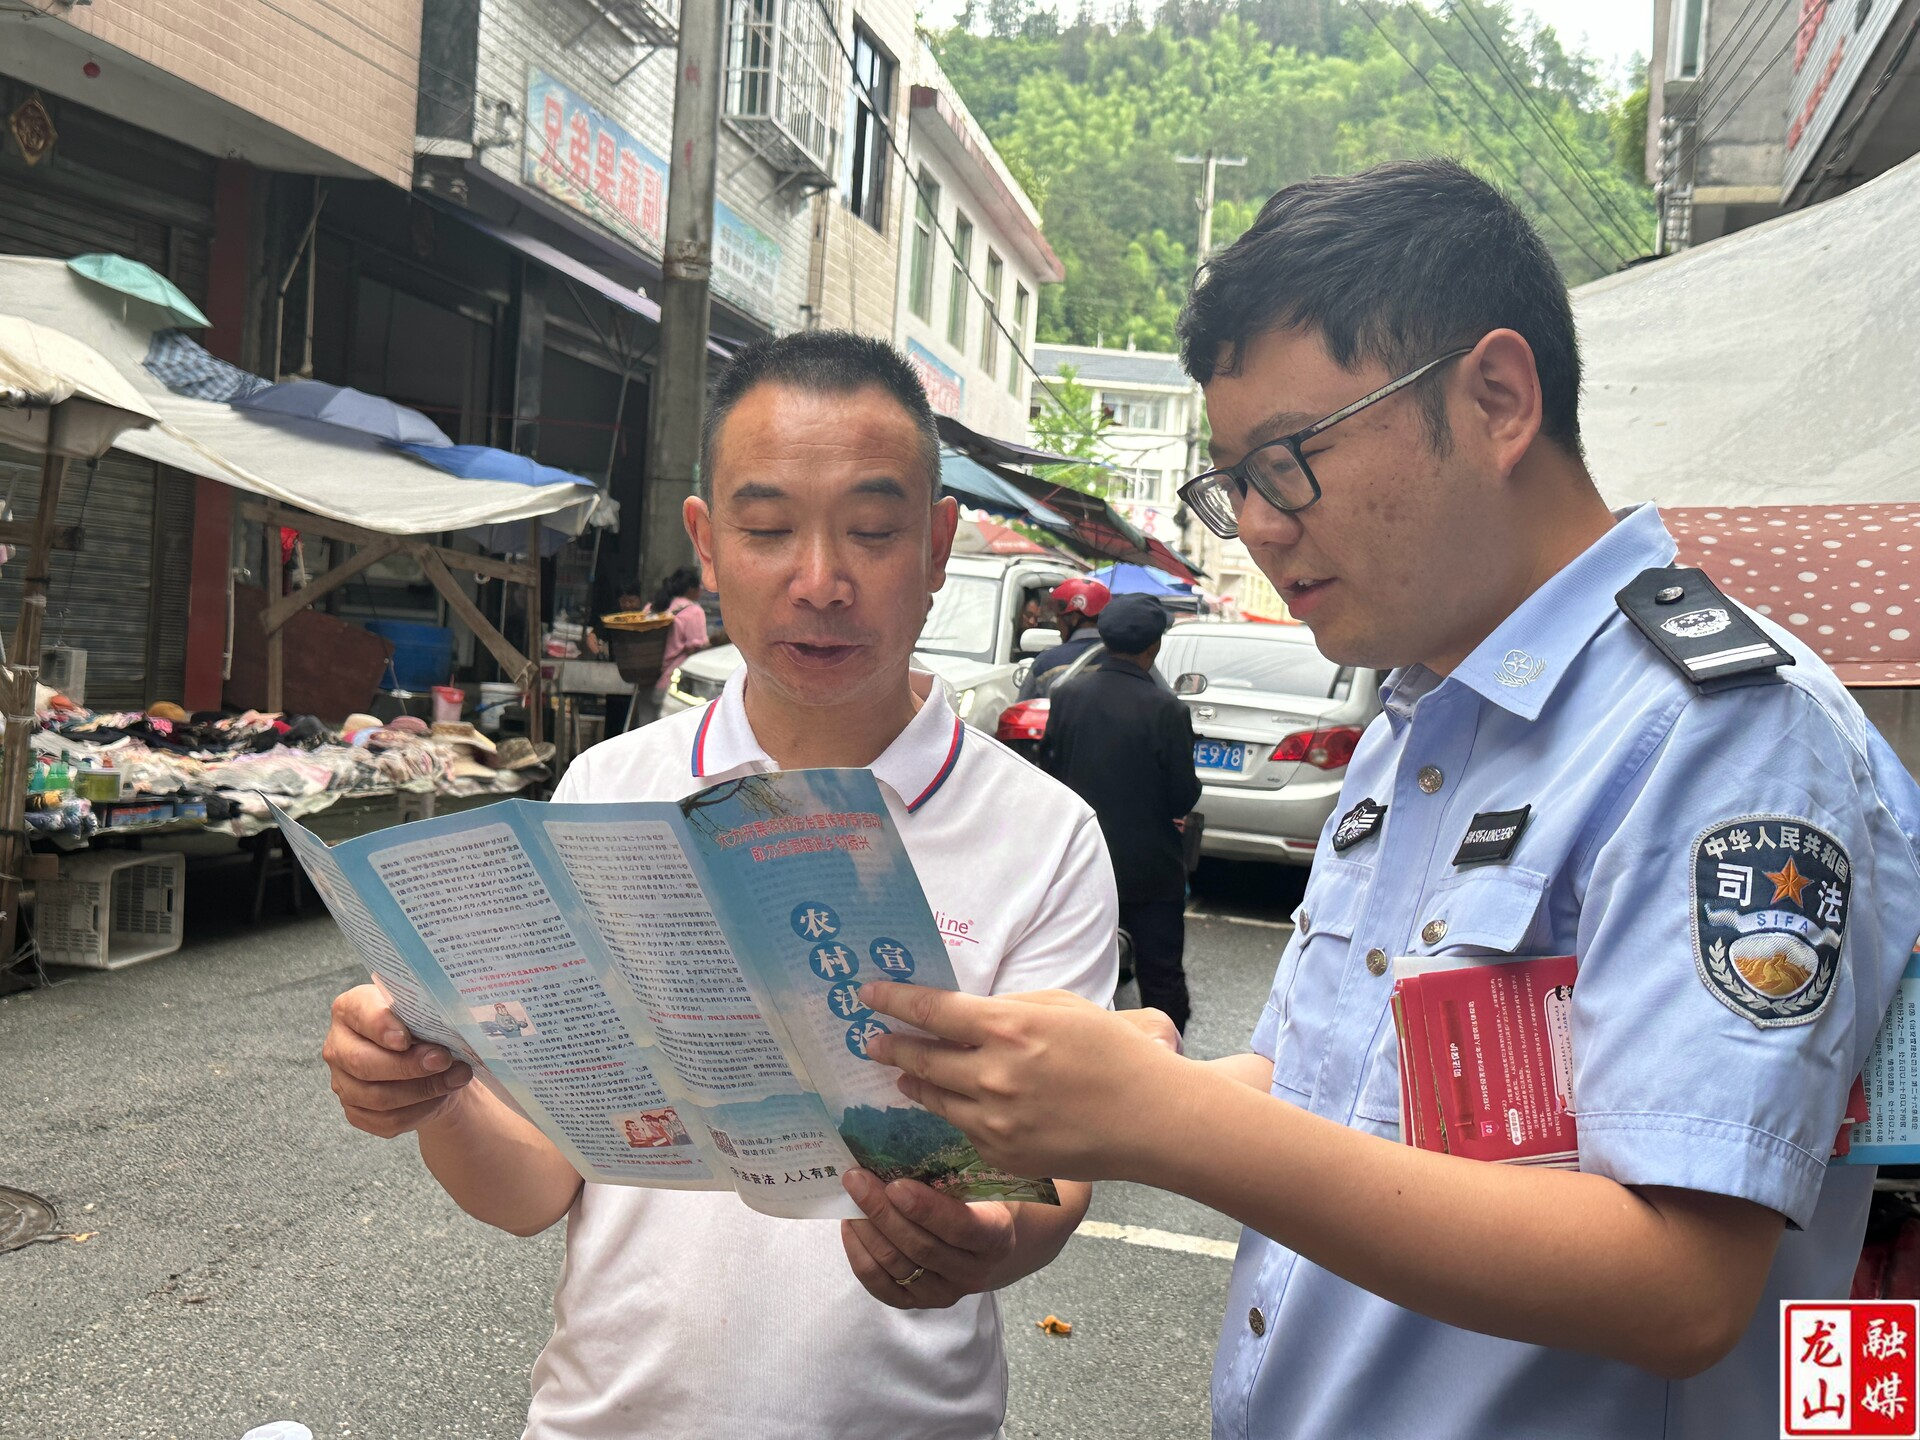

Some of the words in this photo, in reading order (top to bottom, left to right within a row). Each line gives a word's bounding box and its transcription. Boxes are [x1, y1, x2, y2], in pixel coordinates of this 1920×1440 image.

[1193, 742, 1240, 767] E978
[1704, 826, 1849, 883] 中华人民共和国
[1717, 863, 1753, 907] 司
[1817, 880, 1843, 925] 法
[1757, 913, 1809, 933] SIFA
